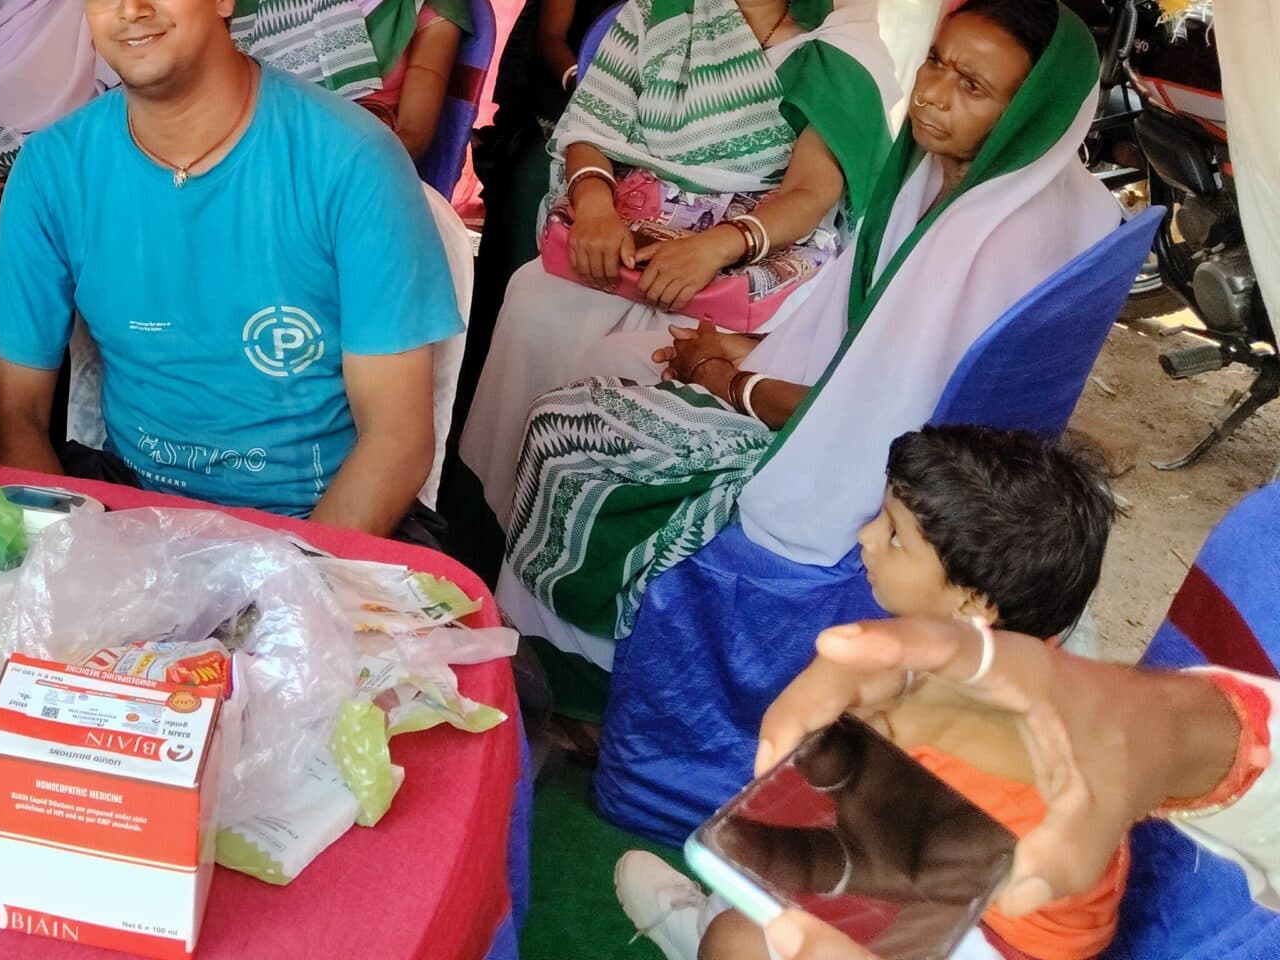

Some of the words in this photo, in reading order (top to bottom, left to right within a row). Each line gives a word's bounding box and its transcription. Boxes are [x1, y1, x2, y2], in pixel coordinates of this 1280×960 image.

[272, 328, 304, 360] P
[48, 747, 91, 761] DILUTIONS
[85, 731, 156, 755] BJAIN
[92, 755, 122, 767] LIQUID
[36, 779, 88, 798] HOMOEOPATHIC
[90, 788, 124, 804] MEDICINE
[11, 912, 79, 941] BJAIN
